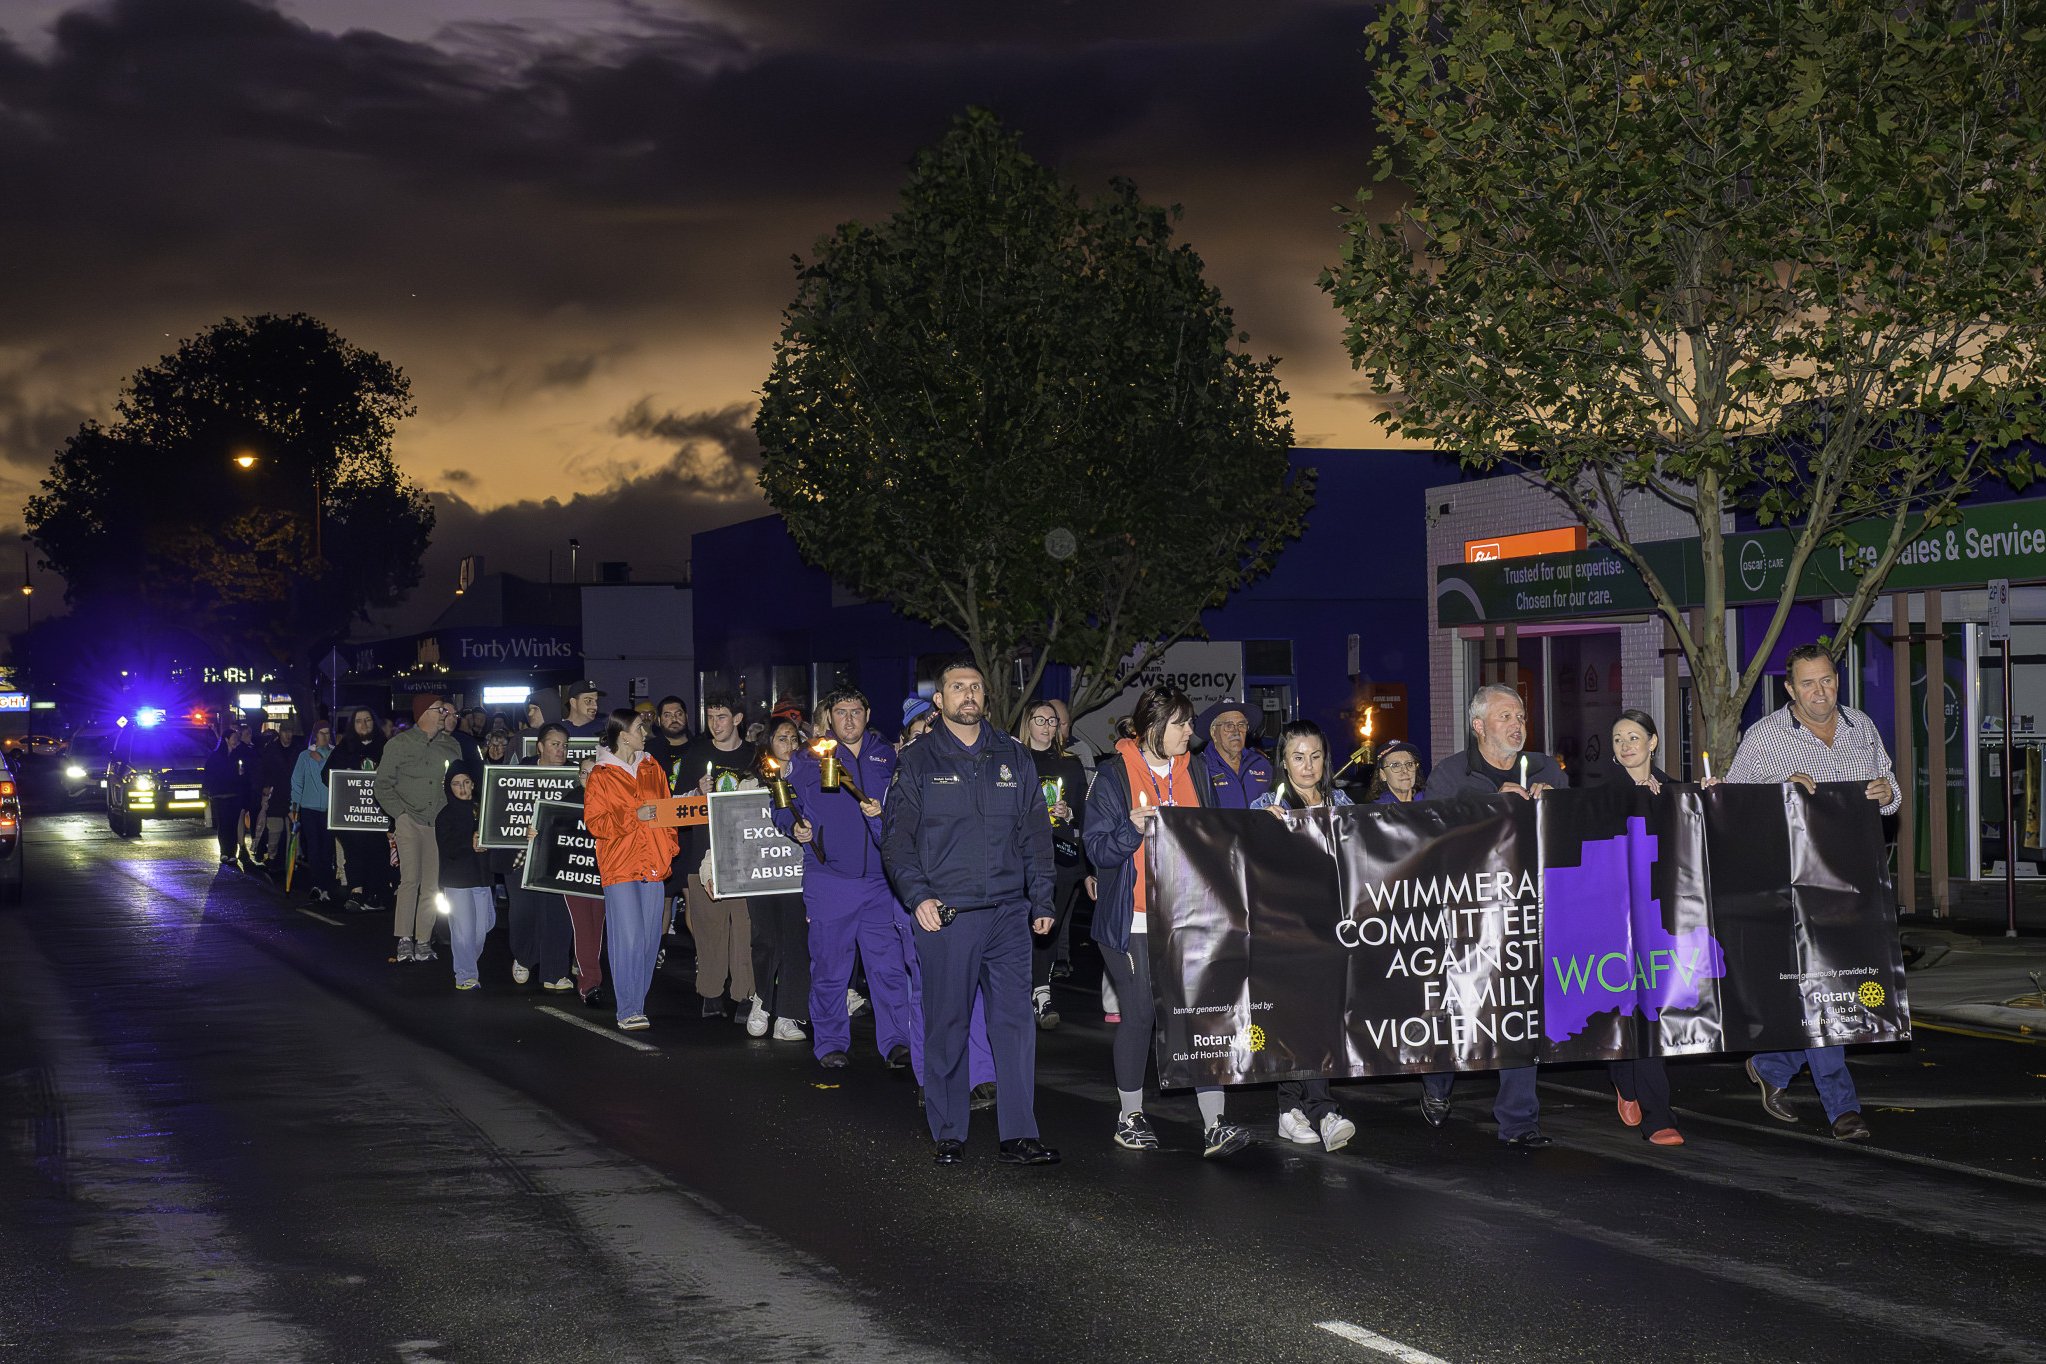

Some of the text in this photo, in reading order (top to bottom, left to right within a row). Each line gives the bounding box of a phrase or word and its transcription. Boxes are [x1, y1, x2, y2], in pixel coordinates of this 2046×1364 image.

[1895, 540, 1942, 566] ales
[1945, 530, 1960, 561] &
[1965, 522, 2046, 559] Service
[1503, 557, 1625, 585] Trusted for our expertise.
[1743, 558, 1784, 571] oscar CARE
[1516, 589, 1613, 610] Chosen for our care.
[347, 779, 362, 787] WE
[498, 777, 575, 789] COME WALK
[359, 788, 374, 796] NO
[507, 790, 563, 801] WITH US
[359, 797, 374, 805] TO
[349, 806, 381, 814] FAMILY
[343, 814, 389, 823] VIOLENCE
[760, 846, 792, 859] FOR
[568, 854, 595, 867] FOR
[555, 869, 601, 886] ABUSE
[751, 865, 804, 879] ABUSE
[1365, 869, 1537, 912] WIMMERA
[1335, 904, 1537, 948] COMMITTEE
[1385, 940, 1538, 979] AGAINST
[1552, 947, 1701, 996] WCAFV
[1801, 968, 1838, 980] generously
[1838, 966, 1868, 977] provided
[1869, 966, 1879, 976] by:
[1424, 974, 1539, 1012] FAMILY
[1813, 991, 1856, 1004] Rotary
[1173, 1005, 1196, 1015] banner
[1196, 1003, 1233, 1015] generously
[1263, 1001, 1274, 1010] by:
[1826, 1005, 1857, 1015] Club of
[1840, 1014, 1858, 1023] East
[1365, 1009, 1539, 1050] VIOLENCE
[1193, 1034, 1236, 1047] Rotary
[1172, 1049, 1237, 1061] Club of Horsham
